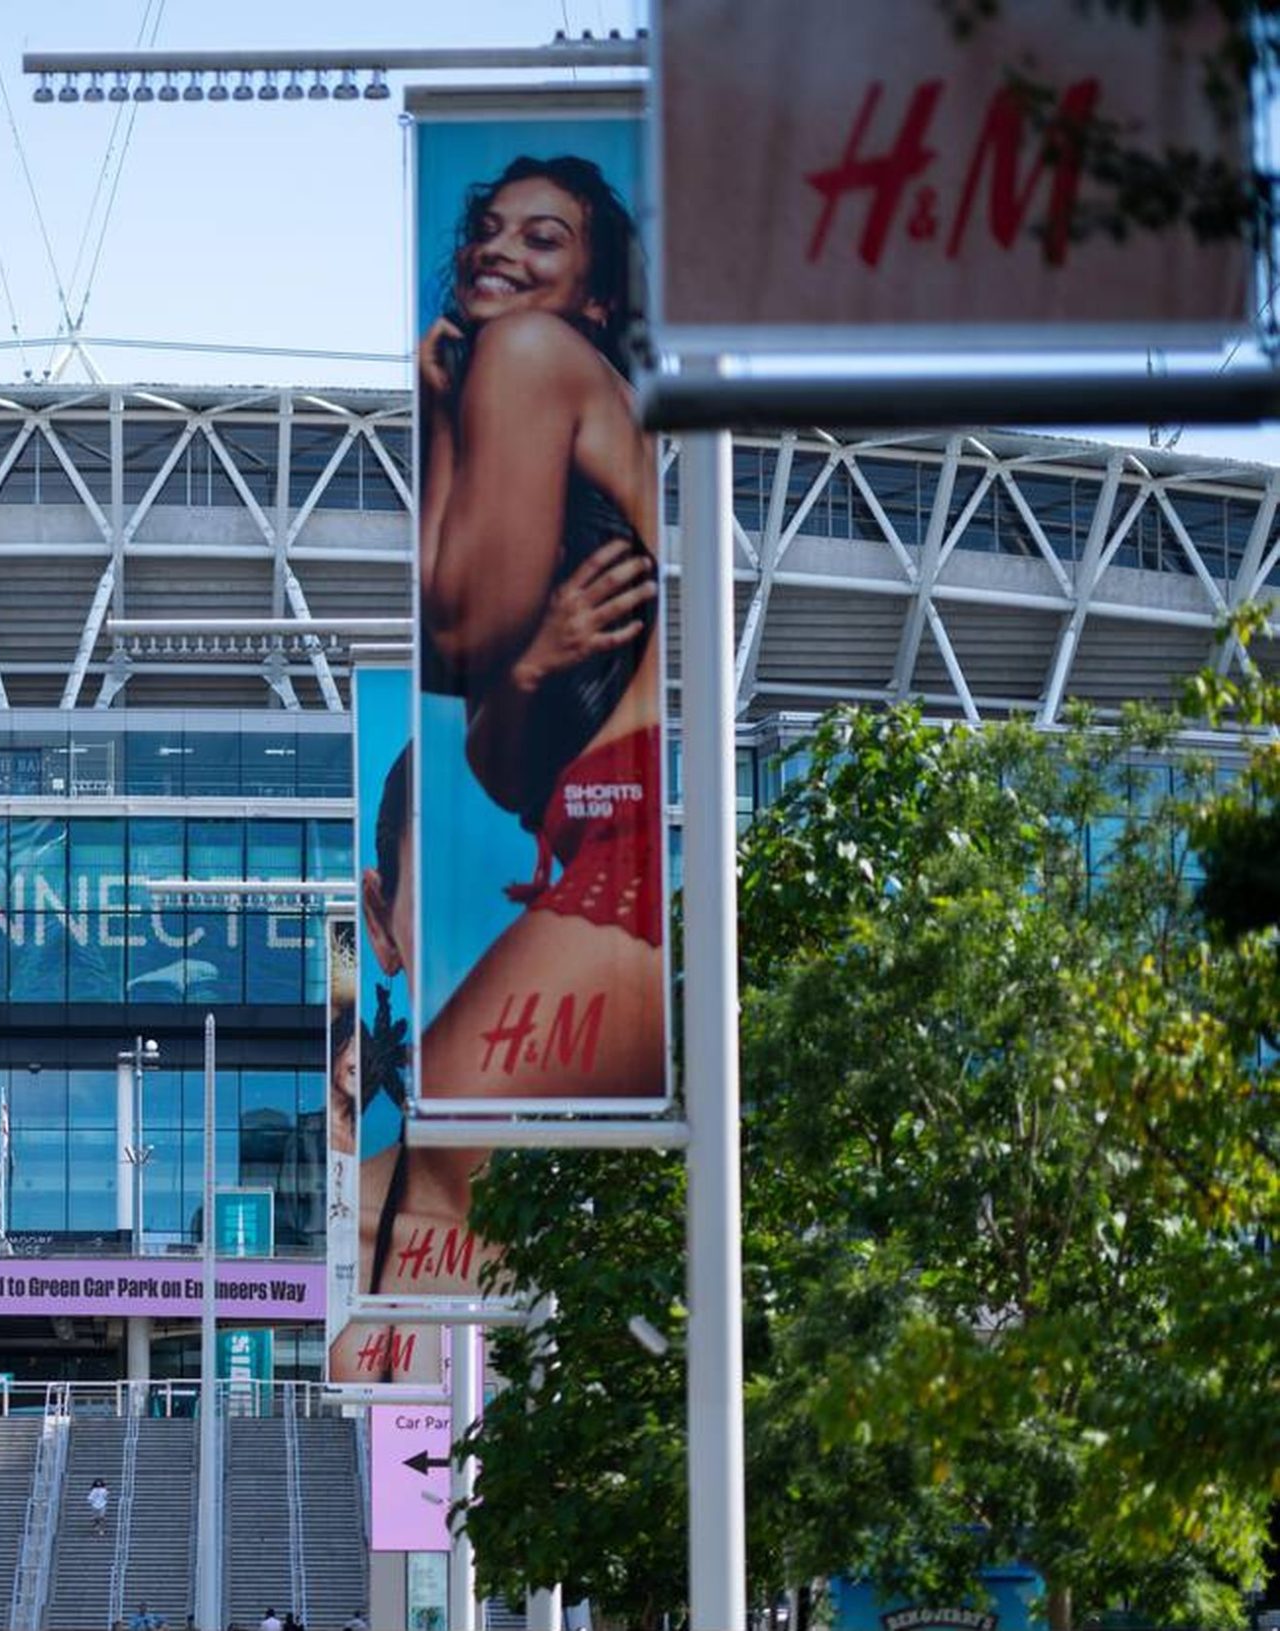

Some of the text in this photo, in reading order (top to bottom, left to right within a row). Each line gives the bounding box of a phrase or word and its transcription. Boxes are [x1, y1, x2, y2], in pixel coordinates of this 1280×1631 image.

[805, 75, 1102, 268] H&M
[564, 784, 643, 801] SHORTS
[480, 992, 607, 1075] H&M
[397, 1227, 475, 1281] H&M
[7, 1276, 25, 1297] to
[29, 1276, 80, 1298] Green
[83, 1277, 115, 1298] Car
[117, 1278, 159, 1299] Park
[161, 1281, 181, 1299] on
[184, 1279, 268, 1301] Enineers
[269, 1280, 306, 1303] Way
[395, 1416, 451, 1430] Car Par
